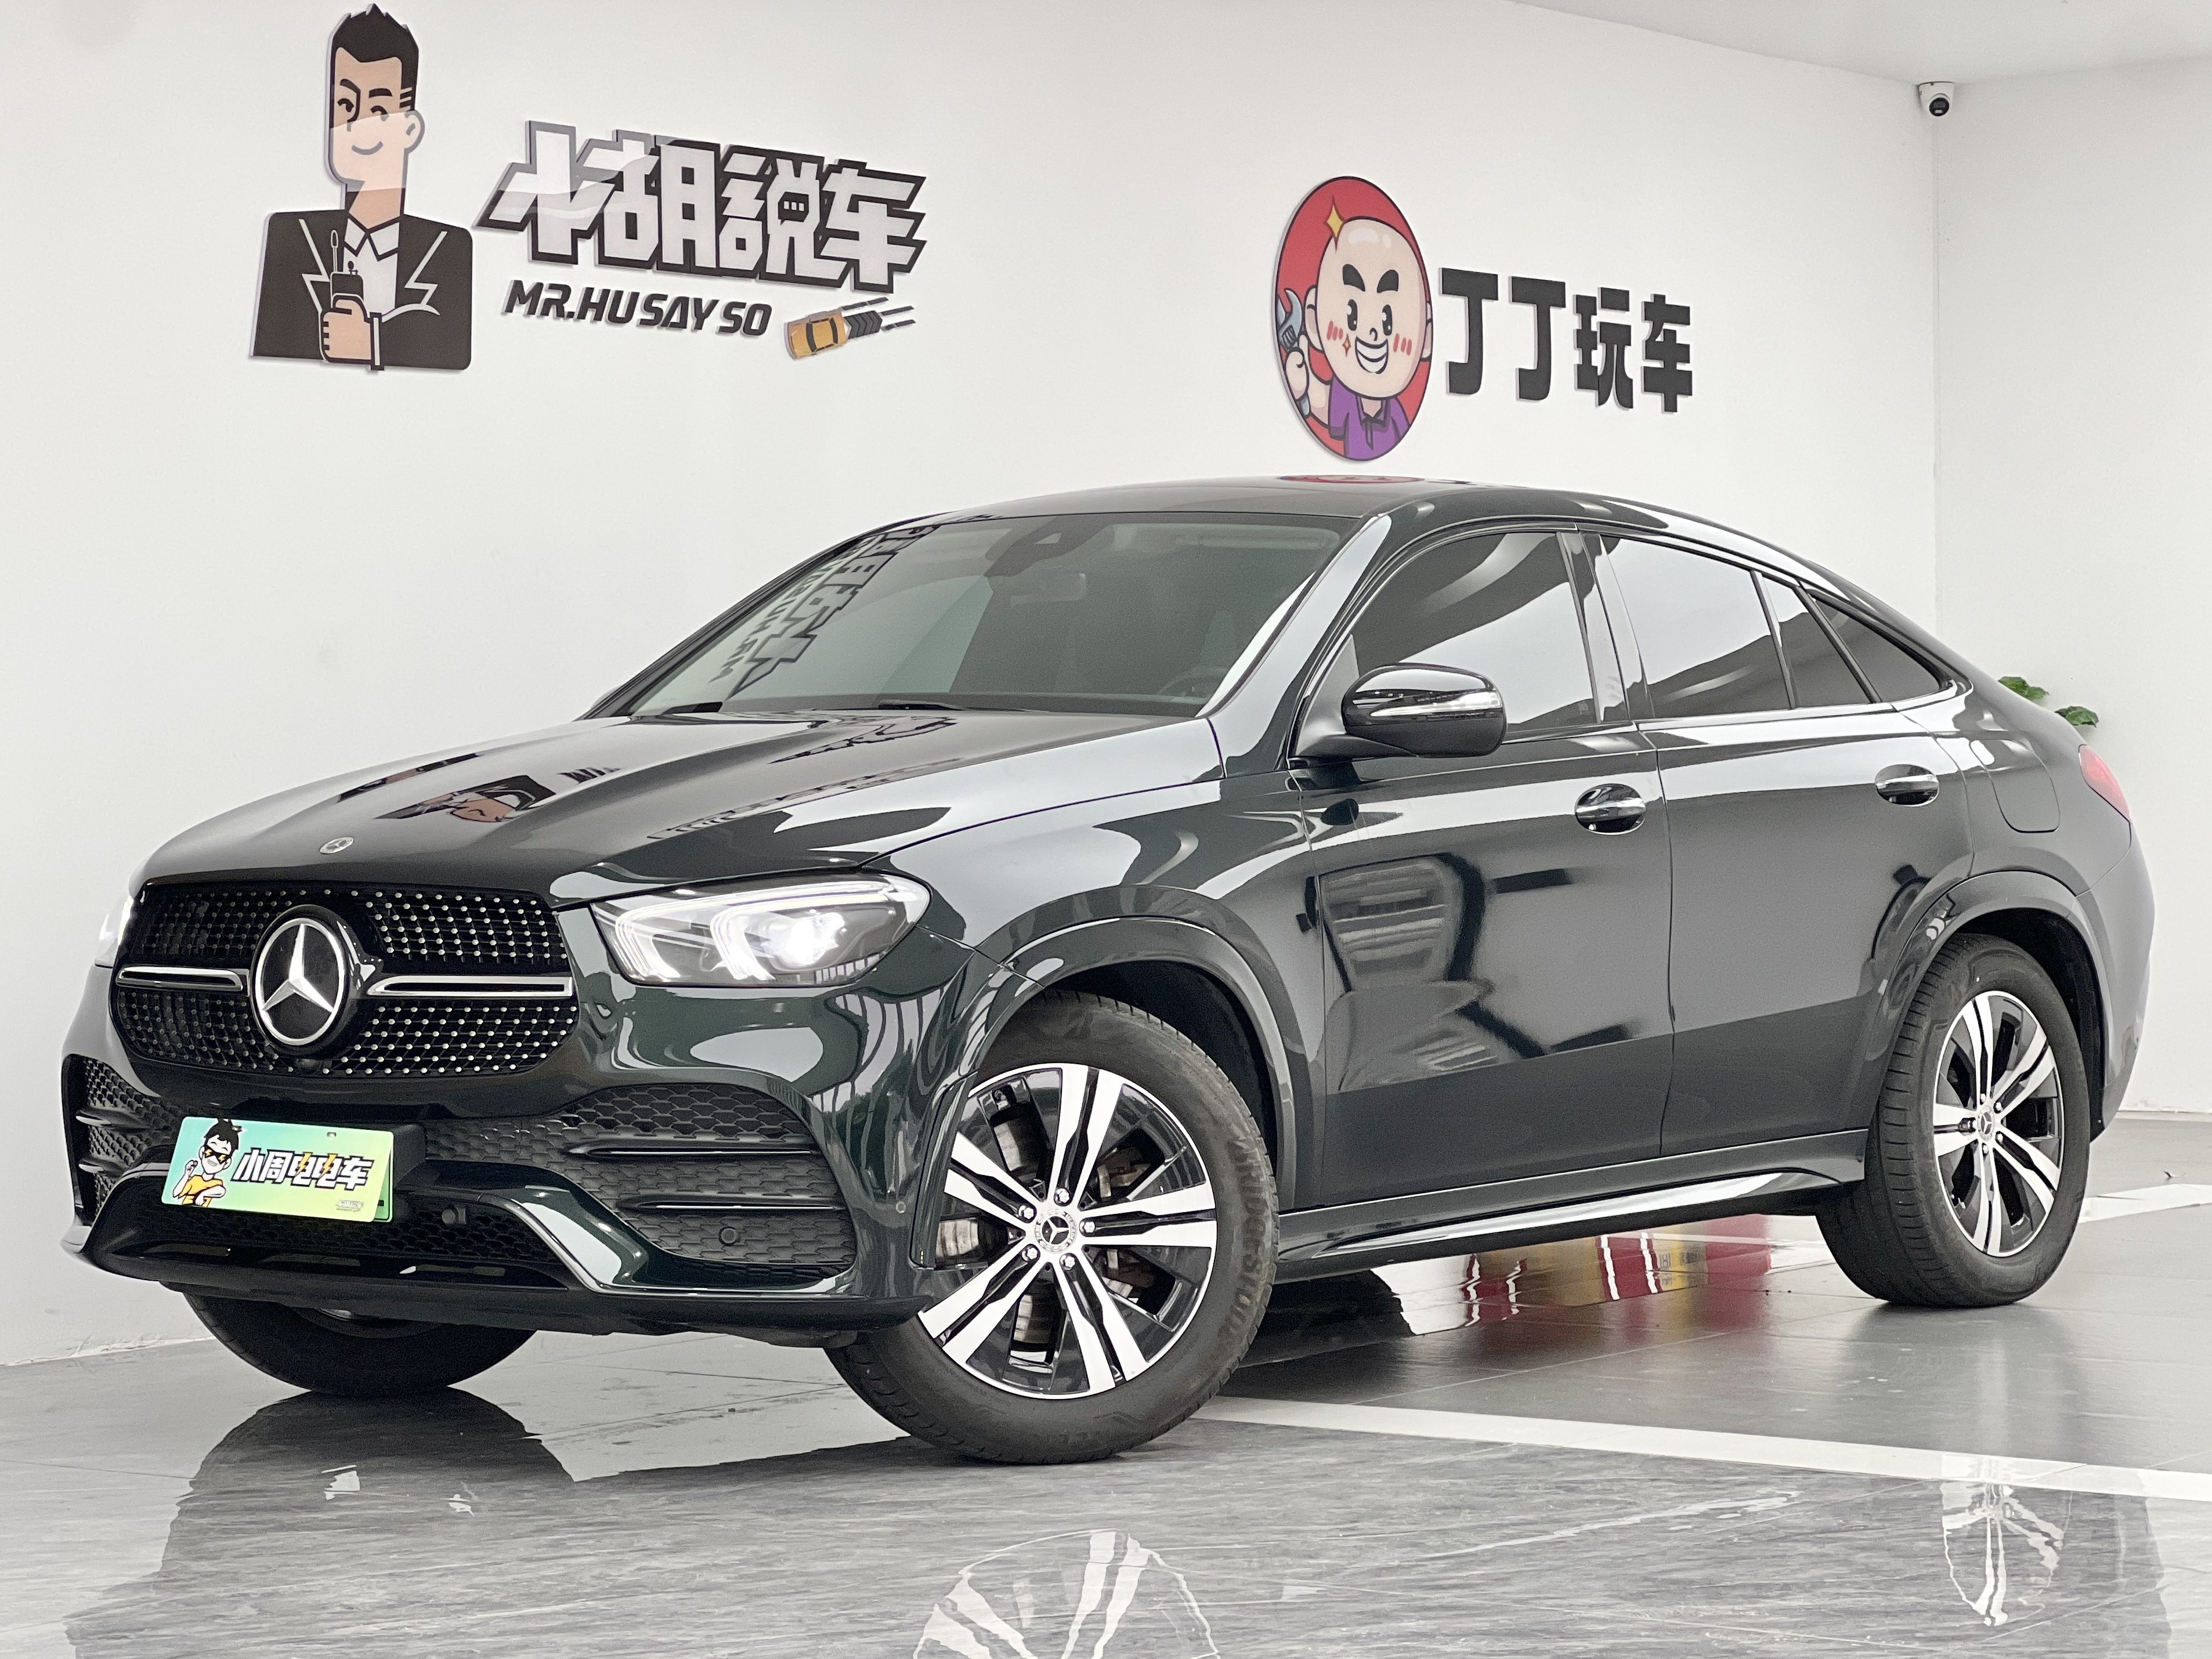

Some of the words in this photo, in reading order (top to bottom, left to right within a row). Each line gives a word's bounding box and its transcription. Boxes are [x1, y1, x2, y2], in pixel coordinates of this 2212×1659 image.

[719, 301, 773, 336] SO
[1440, 268, 1693, 413] 丁丁玩车
[230, 1147, 375, 1191] 小周电电车
